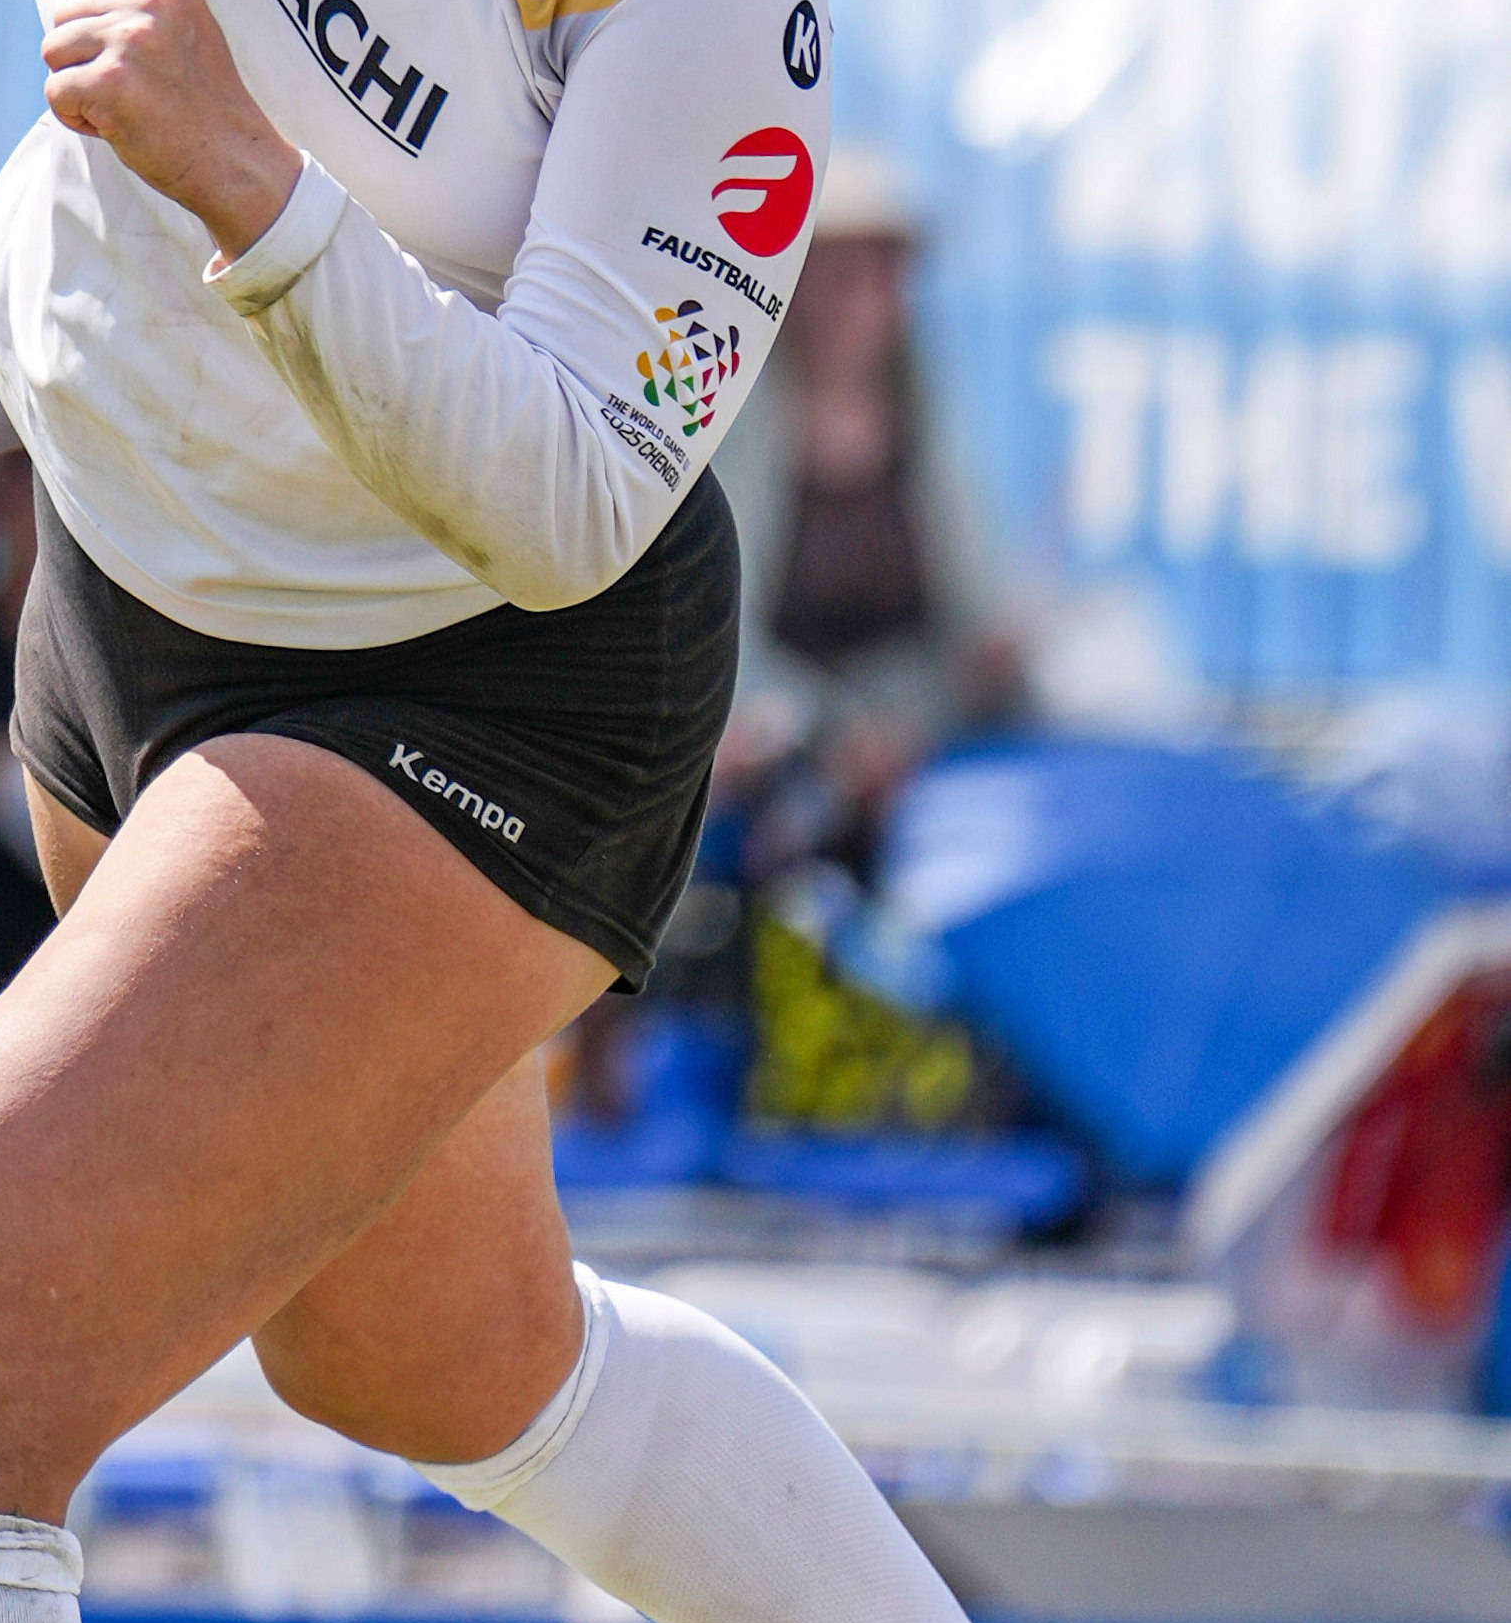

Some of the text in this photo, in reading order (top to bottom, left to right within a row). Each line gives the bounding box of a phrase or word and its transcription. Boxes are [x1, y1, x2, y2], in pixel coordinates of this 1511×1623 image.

[641, 226, 784, 323] FAUSTBALL.DE
[606, 392, 632, 416] THE
[629, 407, 665, 442] WORLD
[1046, 330, 1428, 565] THE
[387, 742, 527, 845] Kempa
